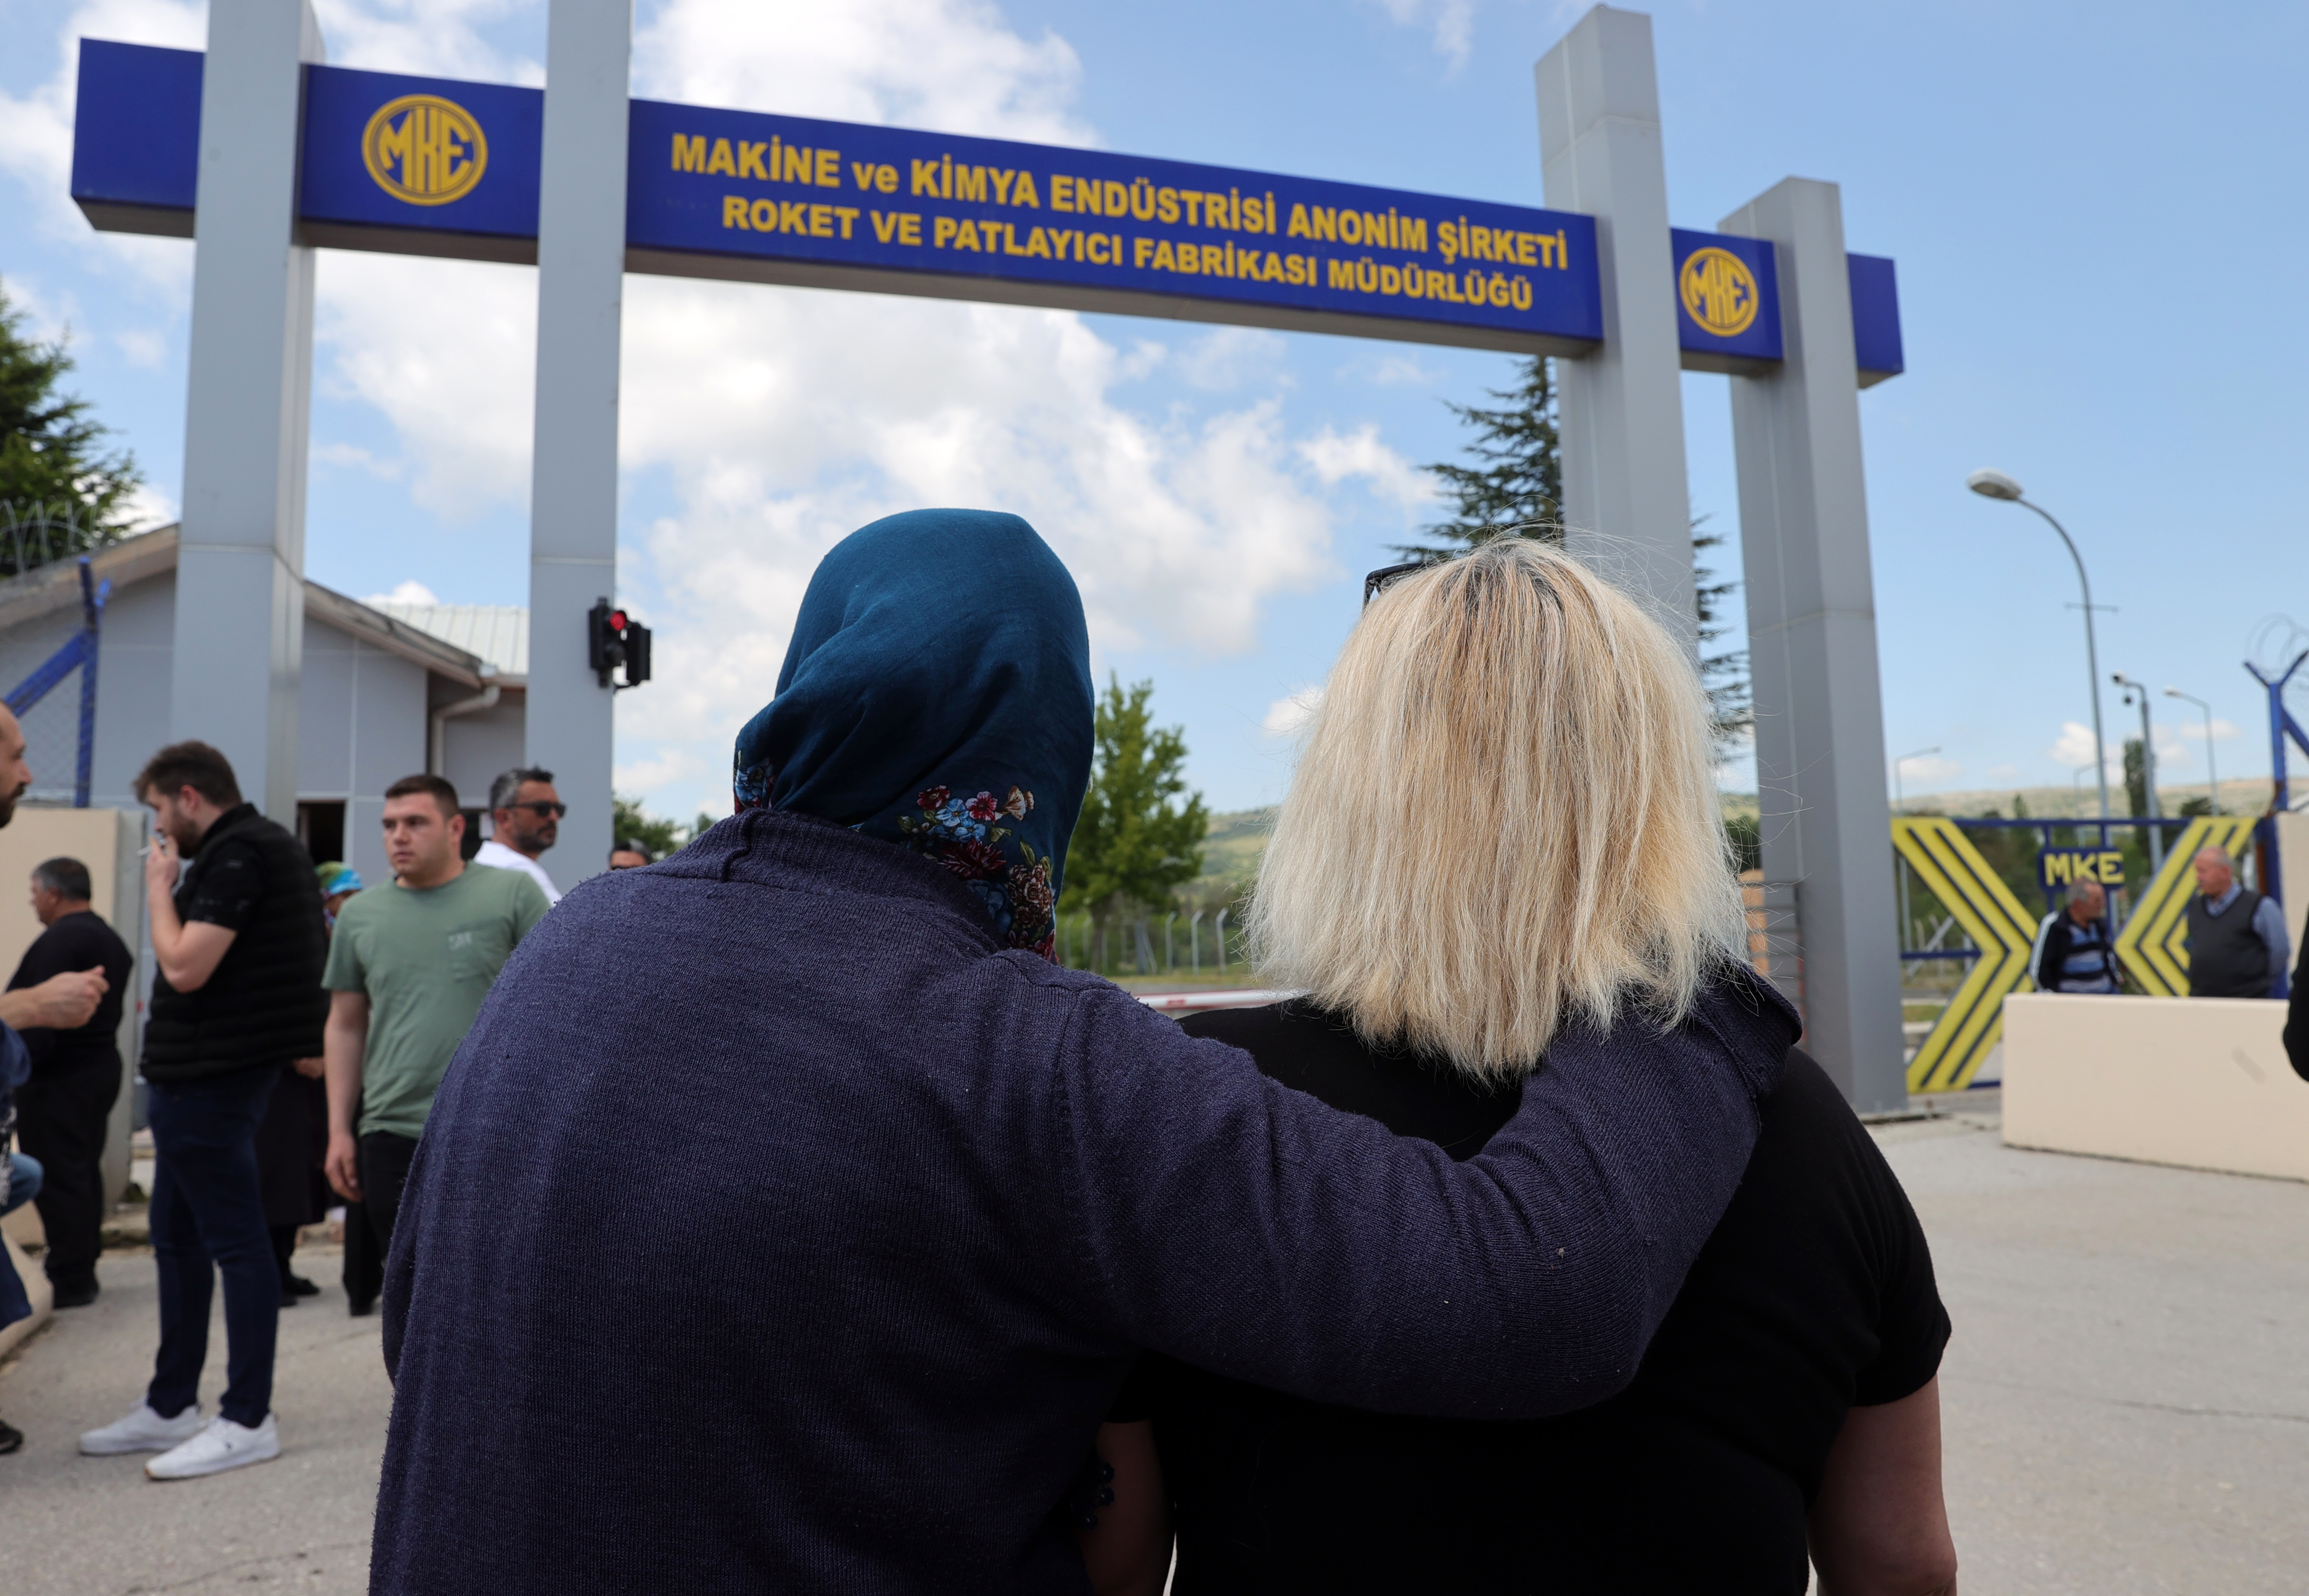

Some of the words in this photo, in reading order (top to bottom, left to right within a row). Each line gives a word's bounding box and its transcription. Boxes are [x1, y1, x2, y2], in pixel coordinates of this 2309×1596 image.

[672, 134, 840, 188] MAKİNE
[852, 162, 898, 193] ve
[911, 155, 1039, 208] KİMYA
[1051, 175, 1277, 234] ENDÜSTRİSİ
[1287, 204, 1428, 252] ANONİM
[1438, 217, 1568, 270] ŞİRKETİ
[723, 196, 860, 240] ROKET
[871, 211, 922, 245] VE
[934, 217, 1122, 266] PATLAYICI
[1134, 238, 1318, 287] FABRİKASI
[1328, 260, 1533, 311] MÜDÜRLÜĞÜ
[2044, 852, 2125, 886] MKE
